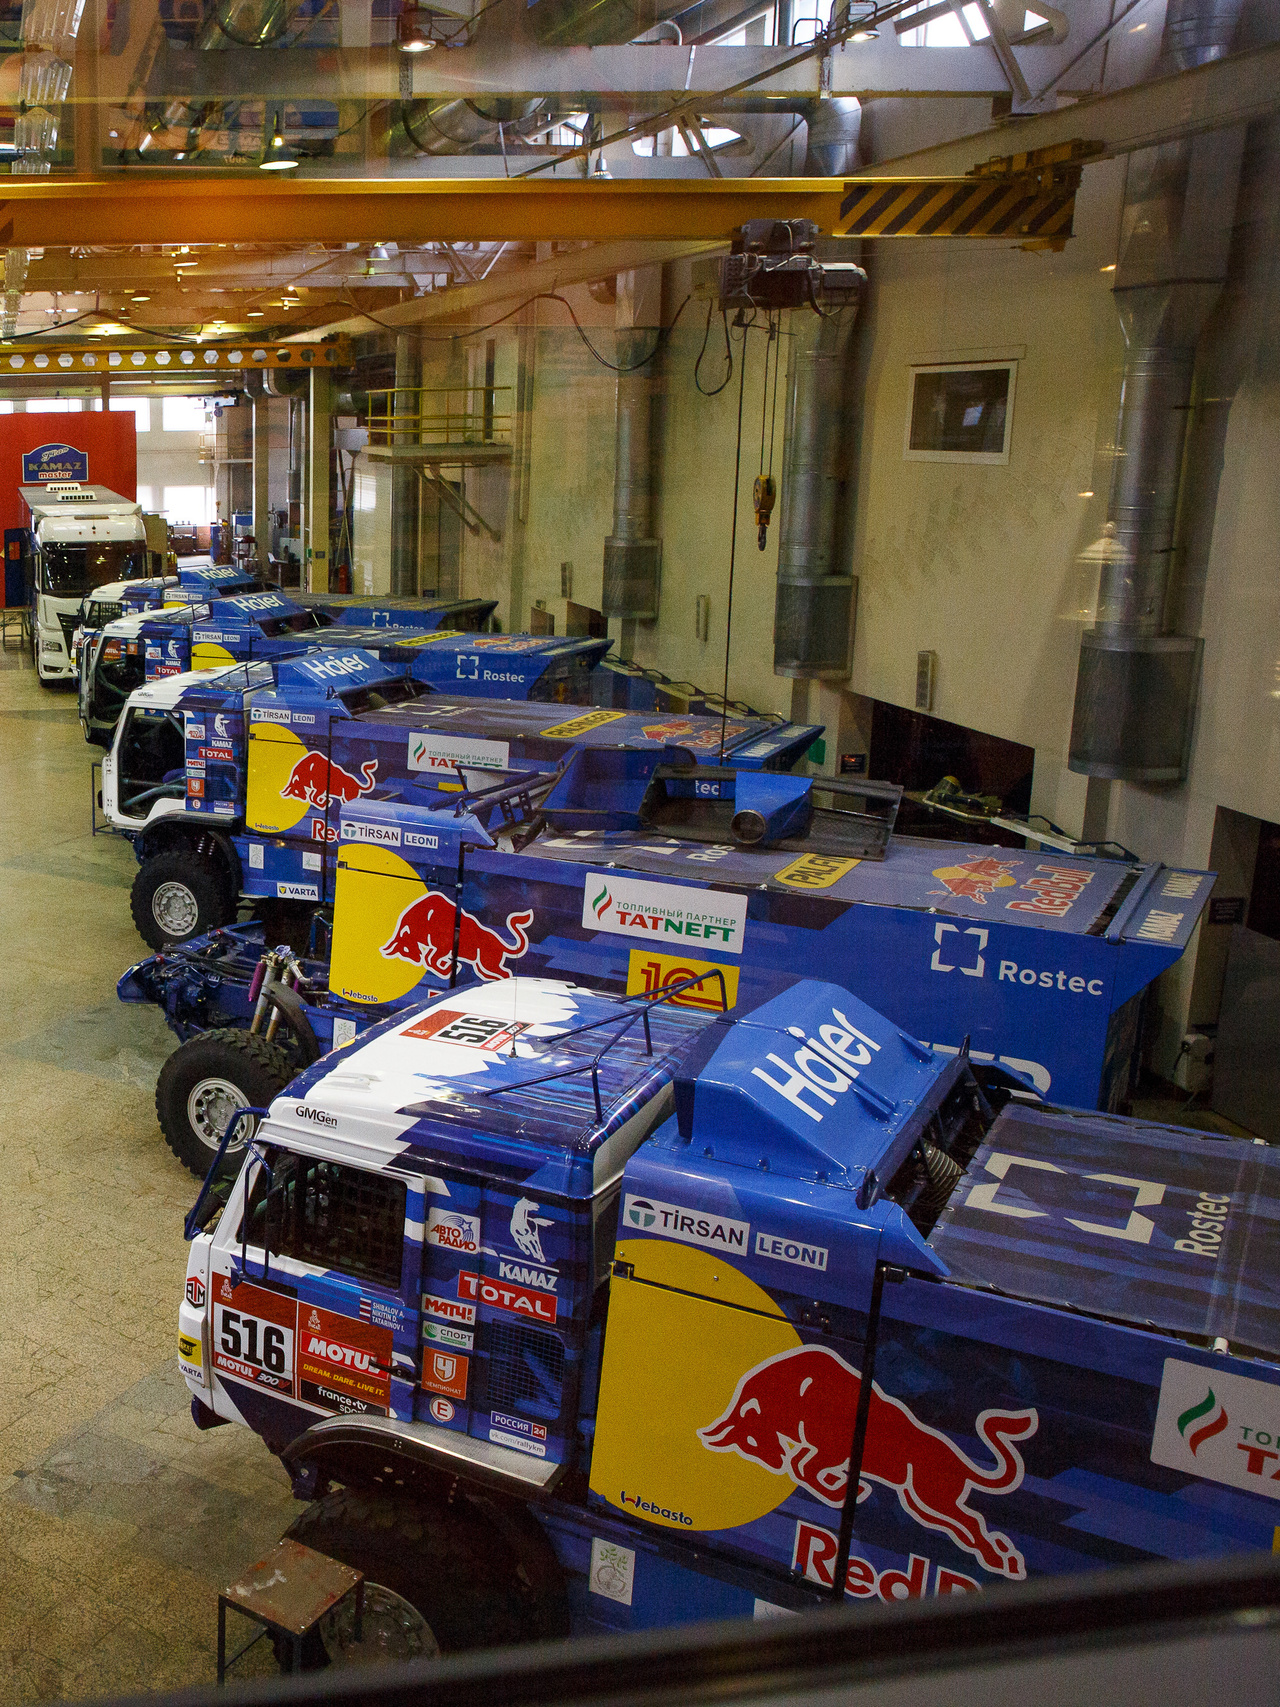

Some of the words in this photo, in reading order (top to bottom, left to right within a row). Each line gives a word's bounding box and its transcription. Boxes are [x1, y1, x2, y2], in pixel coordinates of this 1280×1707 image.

[28, 461, 83, 471] KAMAZ
[38, 471, 73, 479] master
[196, 566, 239, 581] Haier
[232, 594, 285, 612] Haier
[157, 666, 180, 674] TOTAL
[301, 653, 371, 679] Haier
[483, 670, 525, 683] Rostec
[293, 714, 315, 723] LEONI
[211, 740, 233, 748] KAMAZ
[200, 748, 231, 759] TOTAL
[428, 750, 471, 760] ТОПЛИВНЫЙ
[471, 754, 503, 763] ПАРТНЕР
[312, 818, 340, 843] Re
[405, 834, 438, 848] LEONI
[288, 886, 317, 897] VARTA
[616, 901, 683, 918] ТОПЛИВНЫЙ
[686, 912, 737, 926] ПАРТНЕР
[615, 910, 735, 942] TATNEFT
[998, 959, 1104, 996] Rostec
[342, 987, 379, 1003] Webasto
[437, 1016, 509, 1044] 516
[750, 1007, 882, 1123] Haier
[295, 1105, 338, 1126] GMGen
[430, 1223, 461, 1239] АВТО
[1173, 1190, 1232, 1258] Rostec
[438, 1234, 477, 1251] РАДИО
[757, 1235, 827, 1268] LEONI
[499, 1261, 558, 1292] KAMAZ
[463, 1276, 552, 1318] TOTAL
[372, 1302, 399, 1315] SHIBALOV
[372, 1309, 392, 1320] NIKITIN
[425, 1296, 473, 1322] МАТЧ!
[372, 1316, 401, 1331] TATARINOV
[221, 1308, 286, 1374] 516
[440, 1328, 473, 1342] СПОРТ
[180, 1364, 203, 1379] VARTA
[217, 1355, 254, 1378] MOTUL
[257, 1372, 291, 1389] 300V
[303, 1363, 332, 1379] DREAM.
[333, 1374, 356, 1387] DARE.
[356, 1382, 376, 1393] LIVE
[375, 1387, 385, 1397] IT.
[425, 1380, 462, 1395] ЧЕМПИОНАТ
[495, 1415, 529, 1432] РОССИЯ
[533, 1427, 545, 1437] 24
[491, 1431, 544, 1453] vk.com/rallykm
[620, 1489, 694, 1527] Webasto
[791, 1519, 931, 1605] Red
